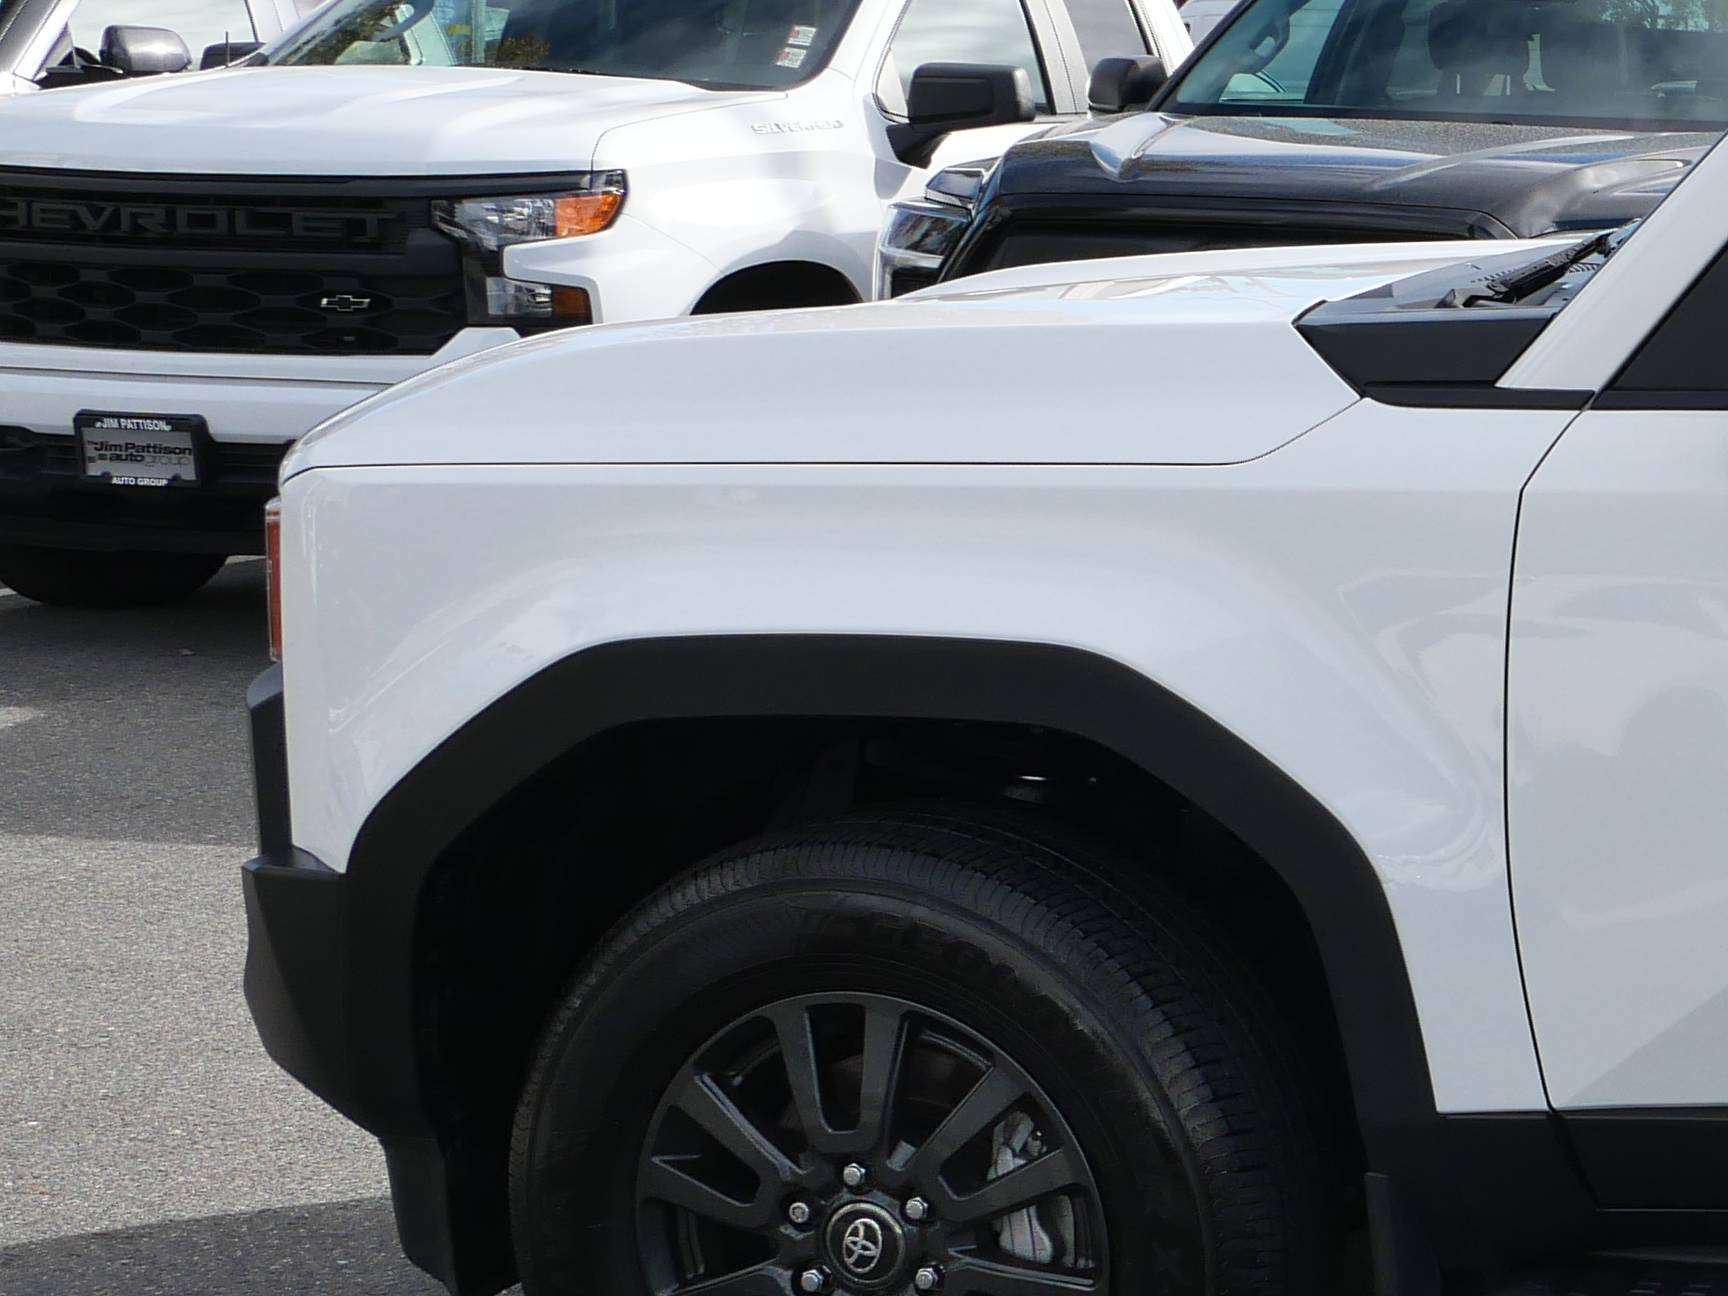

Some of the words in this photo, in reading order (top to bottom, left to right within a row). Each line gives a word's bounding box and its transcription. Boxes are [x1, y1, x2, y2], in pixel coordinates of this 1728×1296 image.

[101, 417, 121, 429] JIM
[121, 418, 168, 431] PATTISON
[111, 477, 136, 486] AUTO
[137, 477, 169, 487] GROUP
